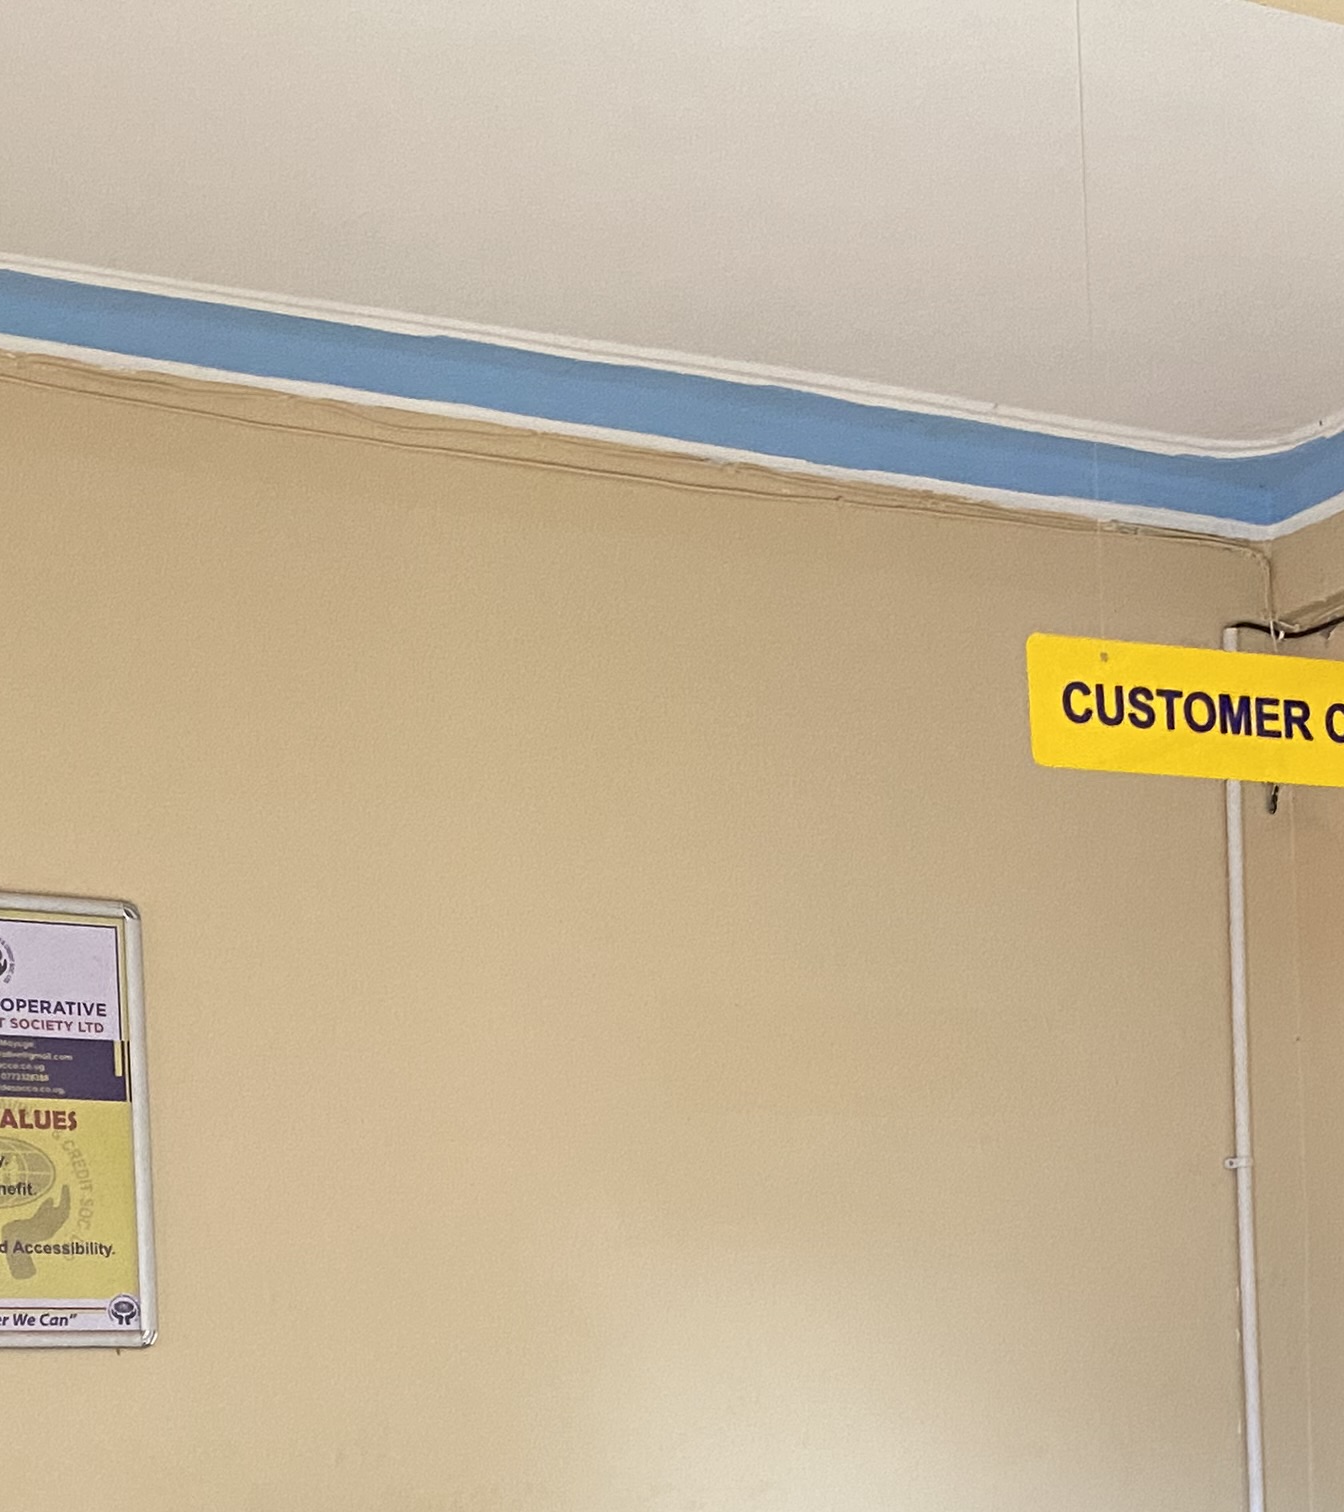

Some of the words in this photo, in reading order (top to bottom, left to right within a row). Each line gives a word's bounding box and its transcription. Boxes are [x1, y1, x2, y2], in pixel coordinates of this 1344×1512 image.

[1062, 681, 1314, 741] CUSTOMER
[10, 1018, 74, 1033] SOCIETY
[78, 1021, 104, 1034] LTD
[13, 1241, 116, 1259] Accessibility.
[13, 1313, 36, 1327] We
